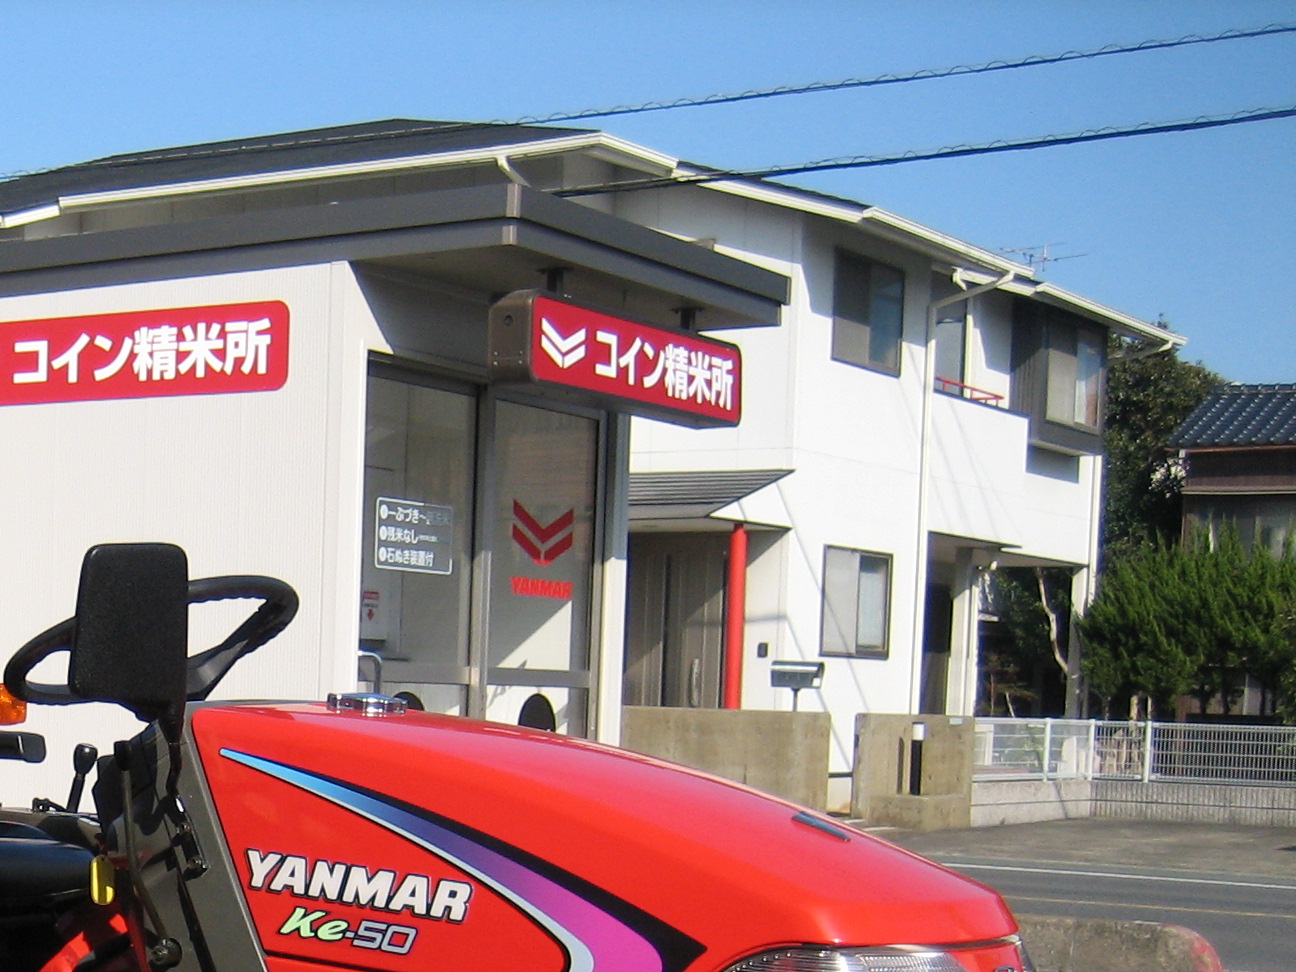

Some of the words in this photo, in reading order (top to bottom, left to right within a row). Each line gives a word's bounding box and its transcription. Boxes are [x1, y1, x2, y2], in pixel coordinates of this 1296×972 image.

[12, 318, 272, 384] コイン精米所
[594, 329, 734, 411] コイン精米所
[511, 576, 572, 599] YANMAR
[245, 848, 474, 923] YANMAR
[278, 906, 418, 955] Ke-50
